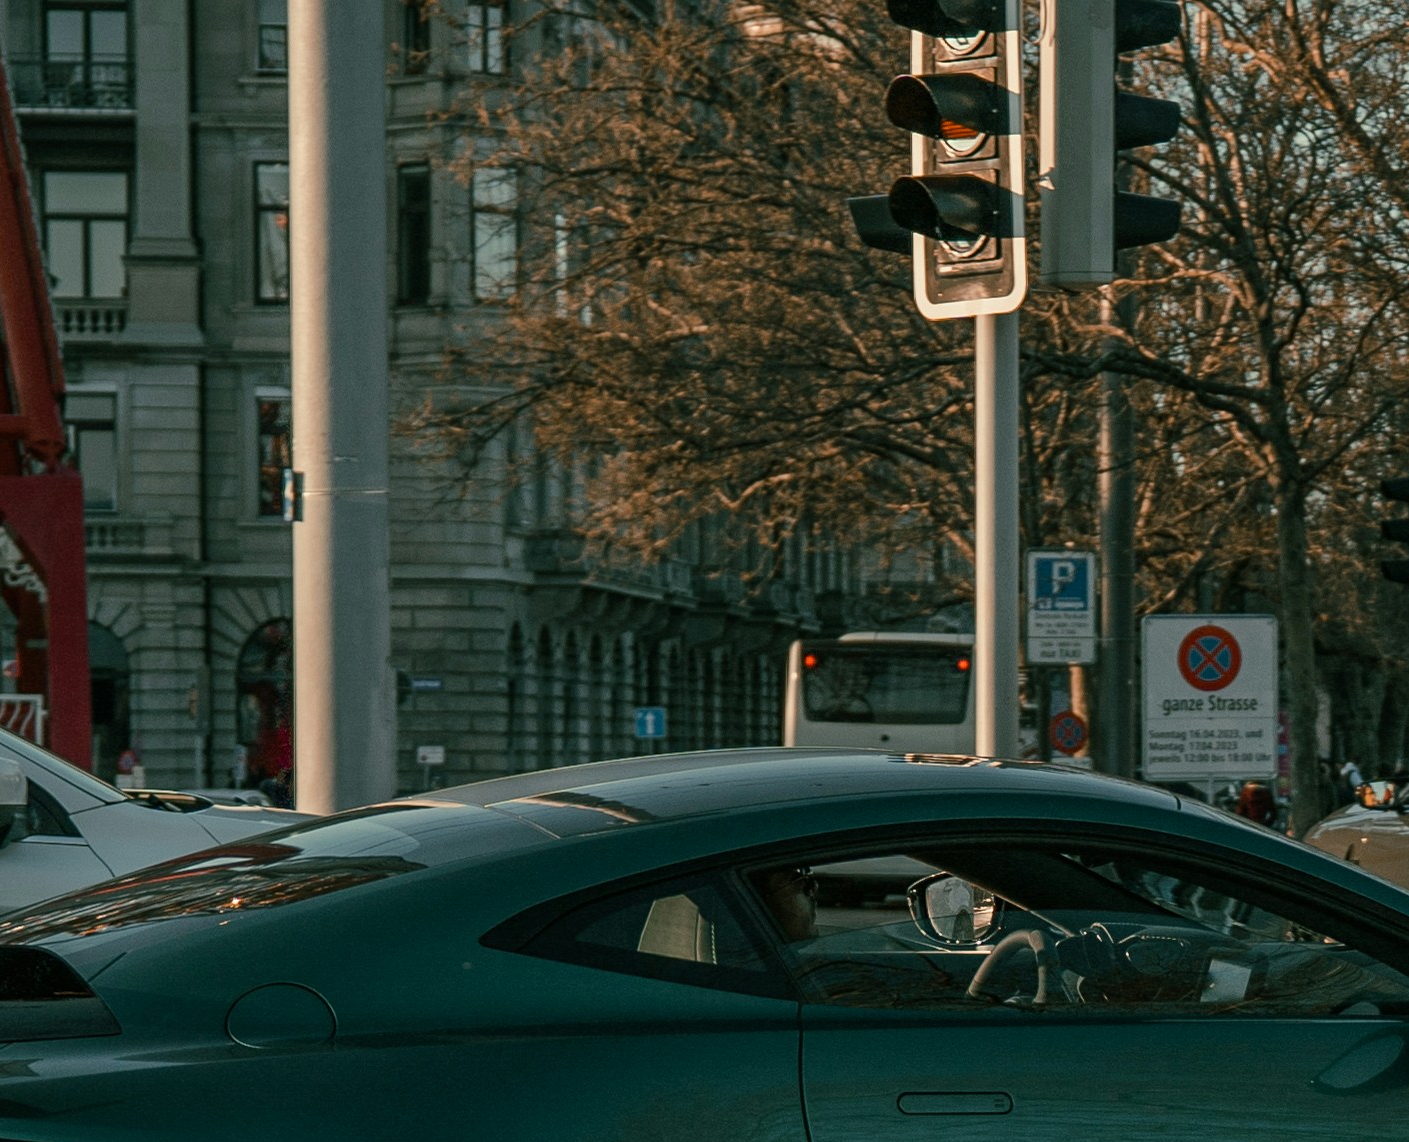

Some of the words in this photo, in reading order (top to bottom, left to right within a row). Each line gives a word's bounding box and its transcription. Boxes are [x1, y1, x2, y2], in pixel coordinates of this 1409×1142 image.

[1052, 560, 1076, 594] P
[1162, 698, 1204, 716] ganze
[1207, 694, 1258, 711] Strasse
[1149, 729, 1187, 741] Sonntag
[1149, 741, 1185, 753] Montag
